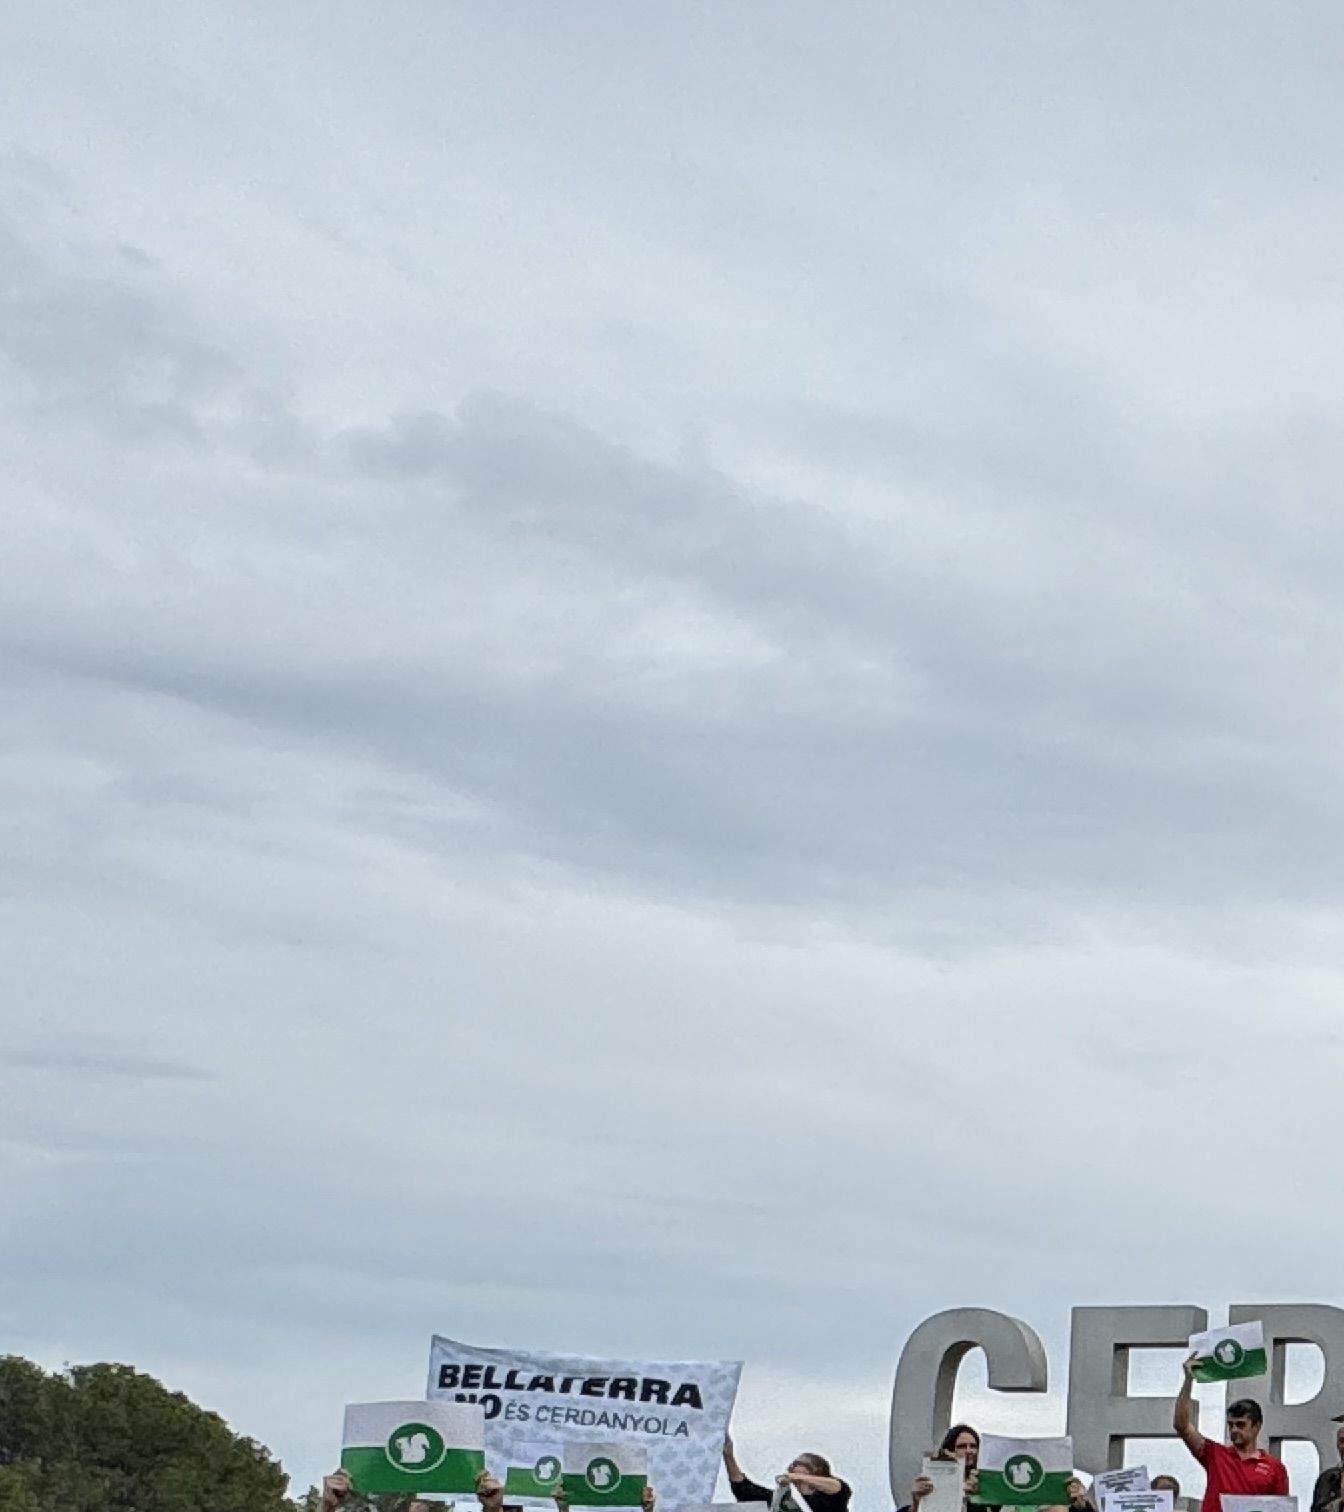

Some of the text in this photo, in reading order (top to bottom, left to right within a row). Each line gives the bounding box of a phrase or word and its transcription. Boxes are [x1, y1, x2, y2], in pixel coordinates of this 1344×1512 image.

[438, 1364, 703, 1409] BELLATERRA
[504, 1399, 531, 1421] ÉS
[535, 1404, 689, 1438] CERDANYOLA
